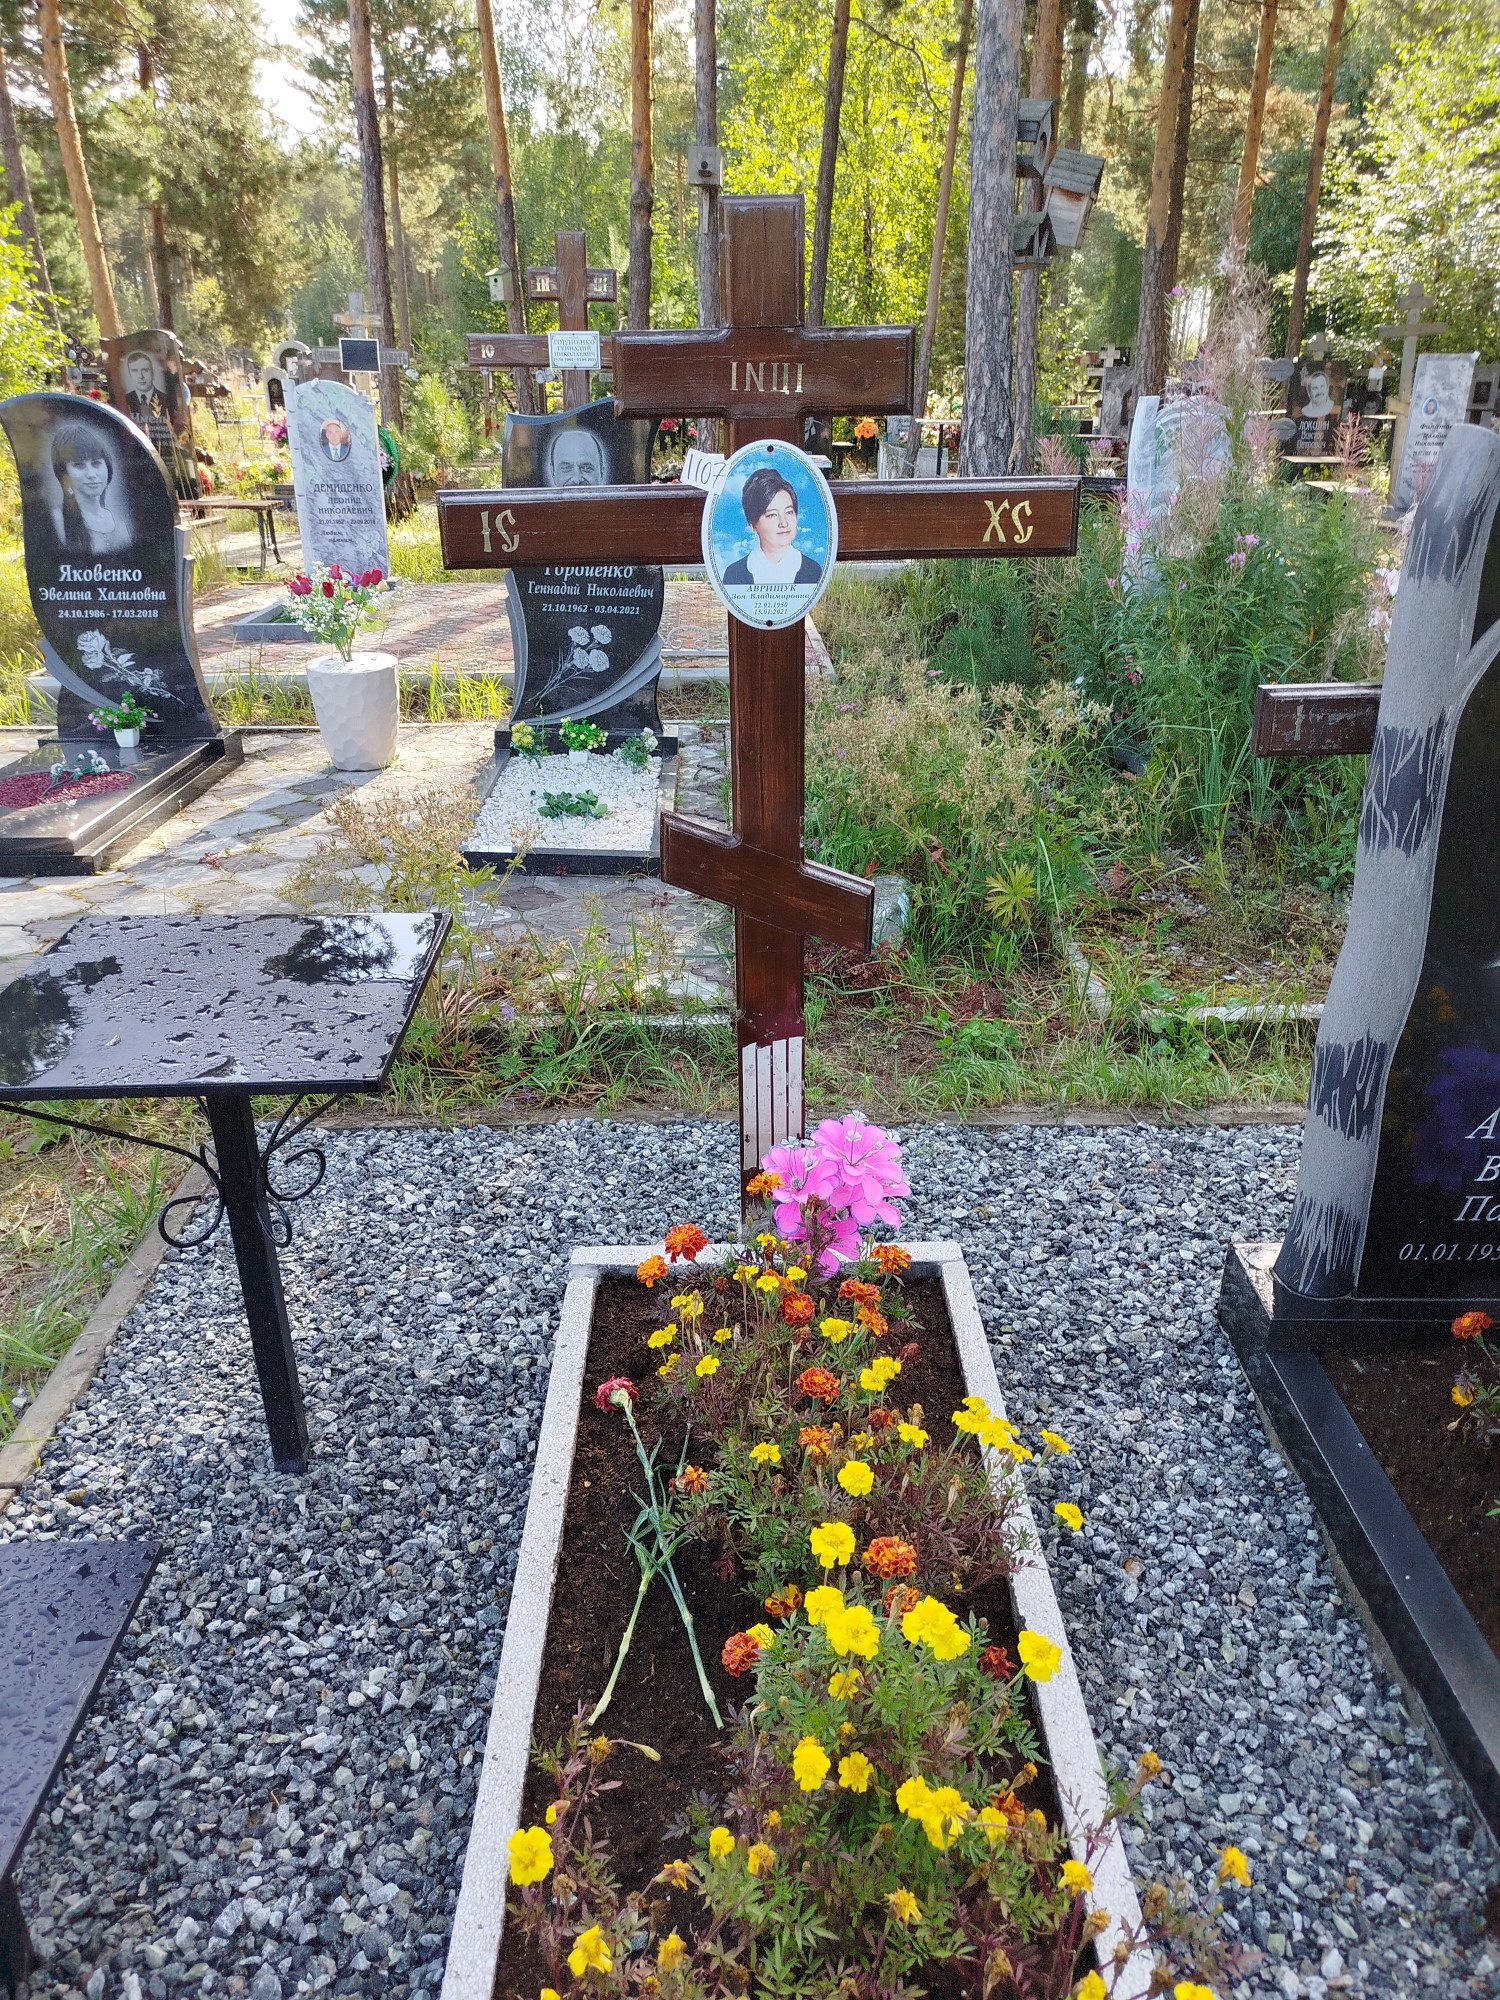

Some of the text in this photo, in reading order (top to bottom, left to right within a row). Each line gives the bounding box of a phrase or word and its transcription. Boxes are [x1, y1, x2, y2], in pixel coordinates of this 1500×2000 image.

[687, 453, 727, 489] 1107
[313, 483, 373, 493] ДЕМИДЕНКО
[318, 507, 373, 515] НИКОЛАЕВИЧ
[58, 563, 142, 582] Яковенко
[39, 587, 167, 601] Эвелина Халиловна
[528, 581, 654, 598] Геннадий Николаевич
[58, 609, 105, 618] 24.10.1986
[112, 609, 159, 618] 17.03.2018
[542, 603, 588, 613] 21.10.1962
[594, 604, 640, 615] 03.04.2021
